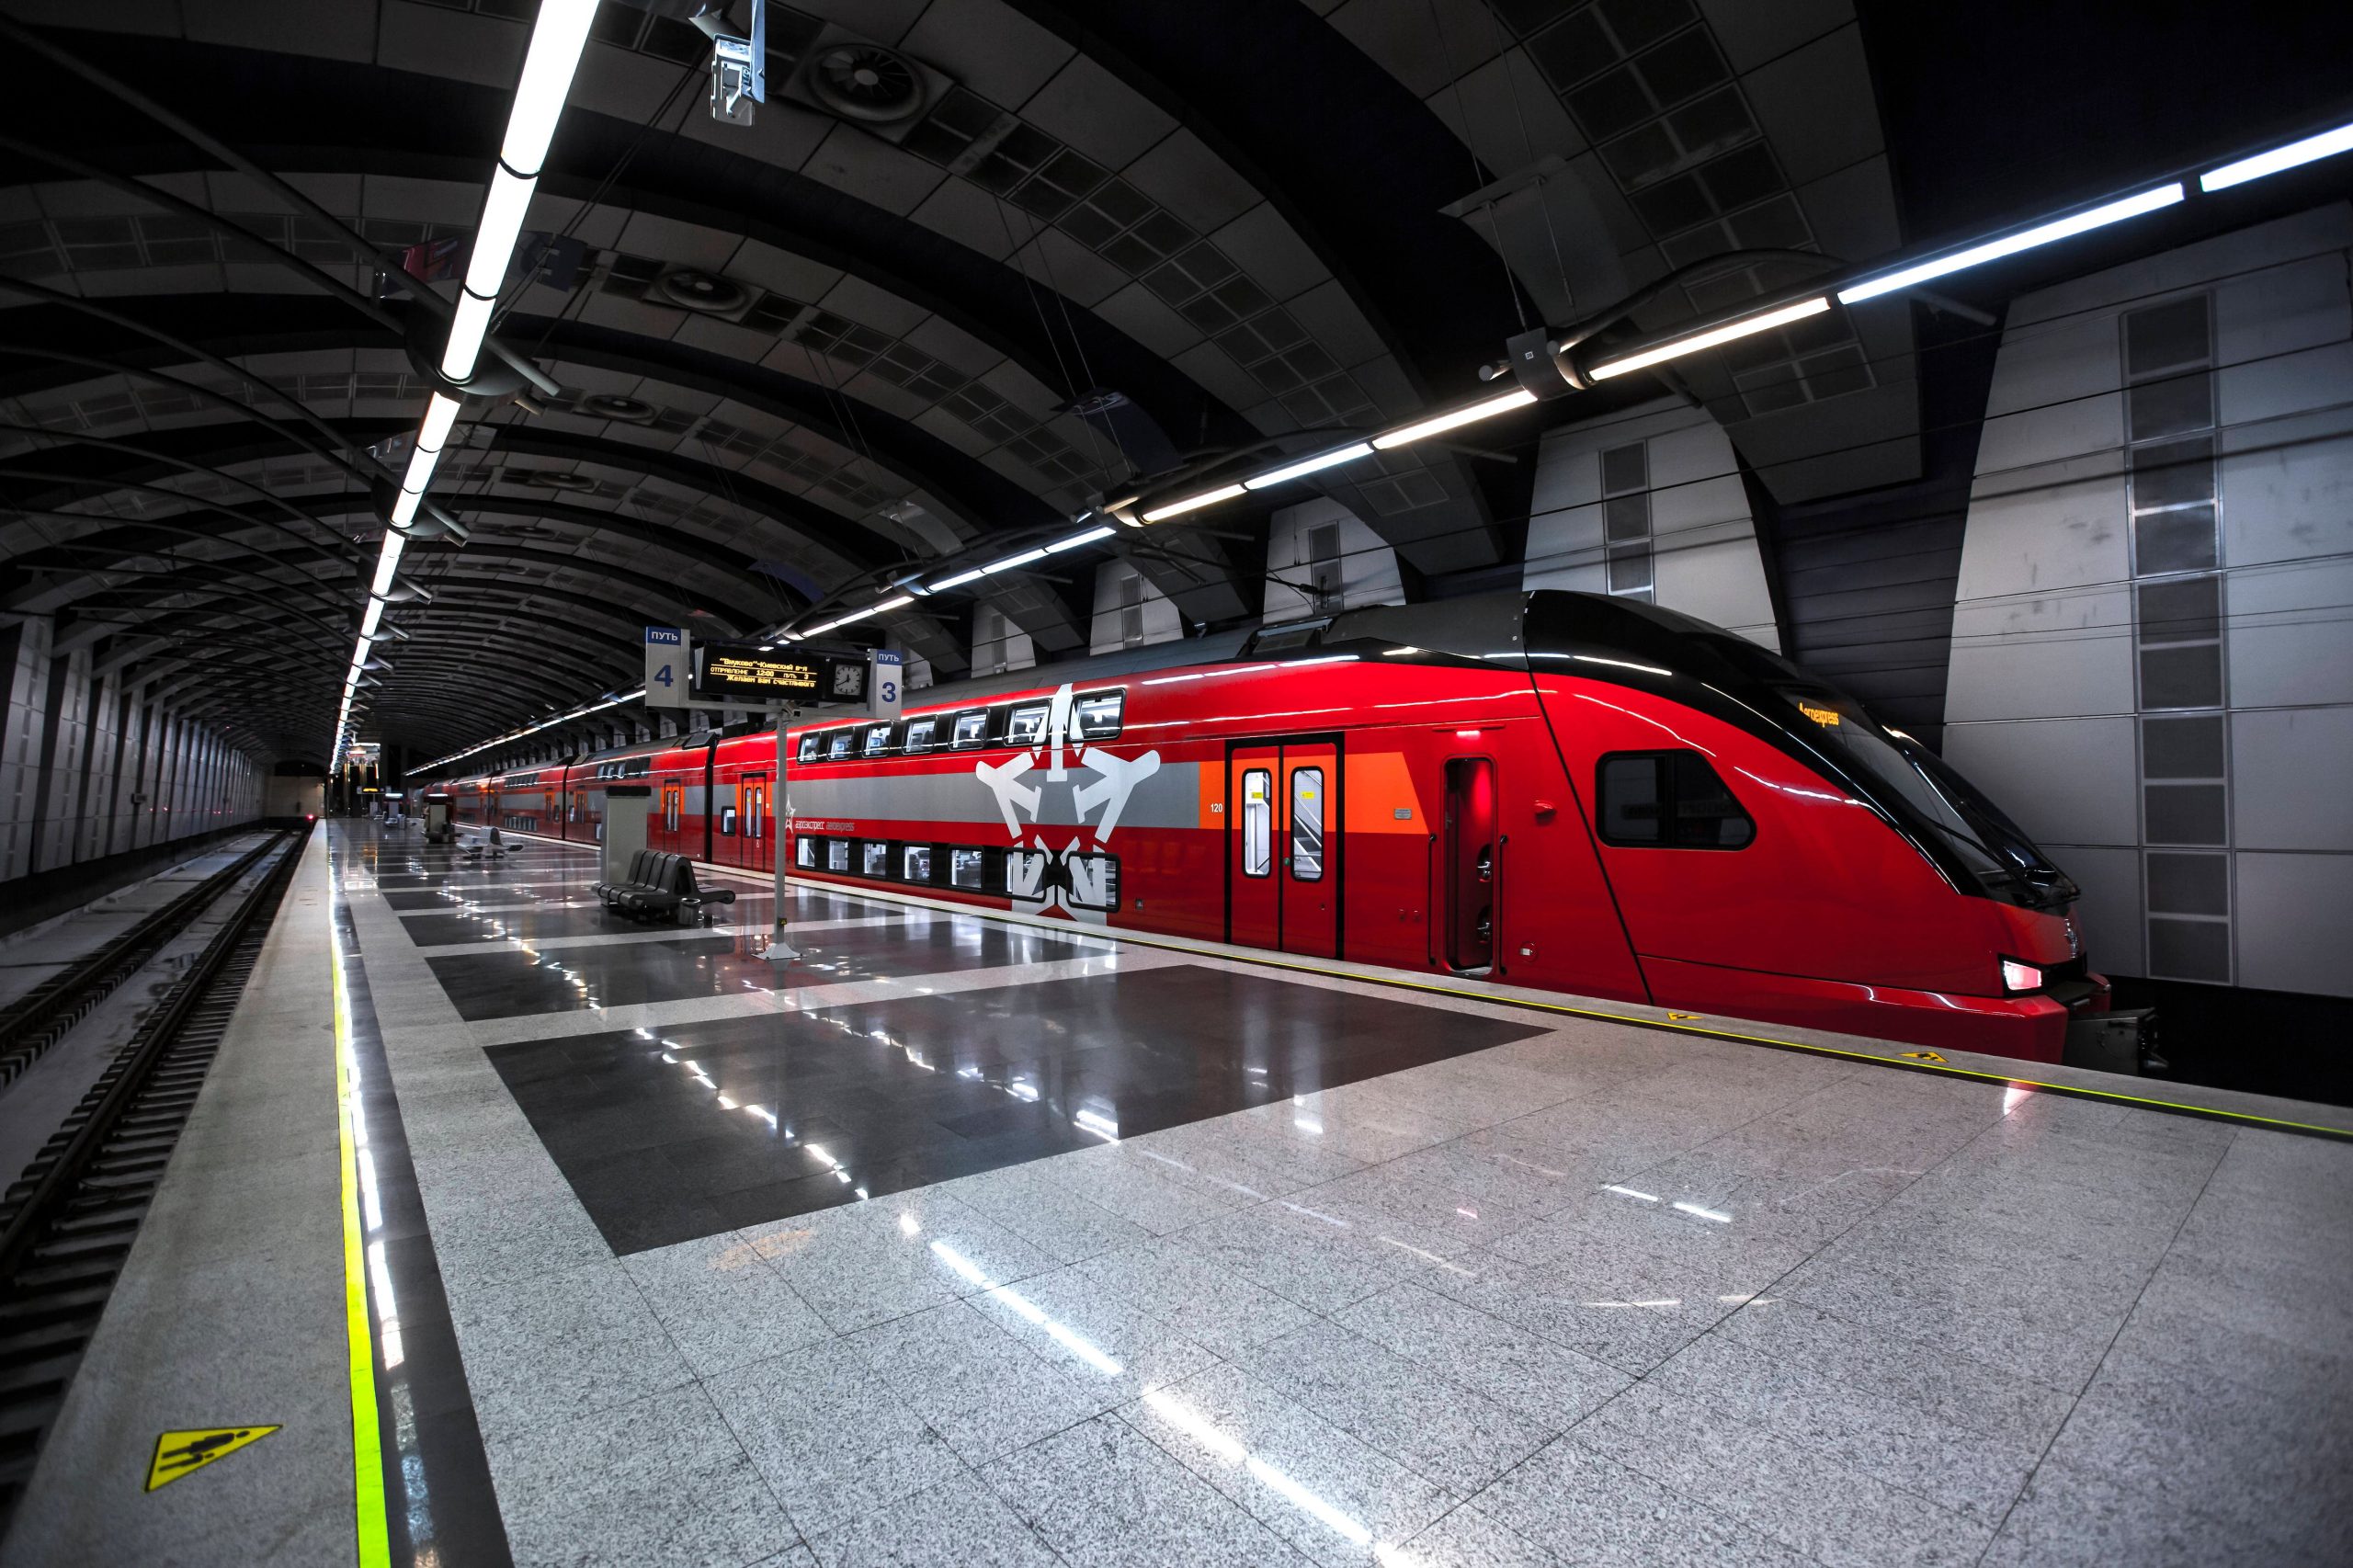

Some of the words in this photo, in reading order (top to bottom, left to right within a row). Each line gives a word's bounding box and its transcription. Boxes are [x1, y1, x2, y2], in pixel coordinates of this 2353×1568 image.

[651, 631, 678, 641] ПУТЬ
[878, 653, 900, 662] ПУТЬ
[654, 665, 674, 687] 4
[726, 674, 756, 683] Желаем
[881, 682, 896, 702] 3
[1799, 701, 1839, 728] Aeroexpress
[1211, 803, 1222, 812] 120
